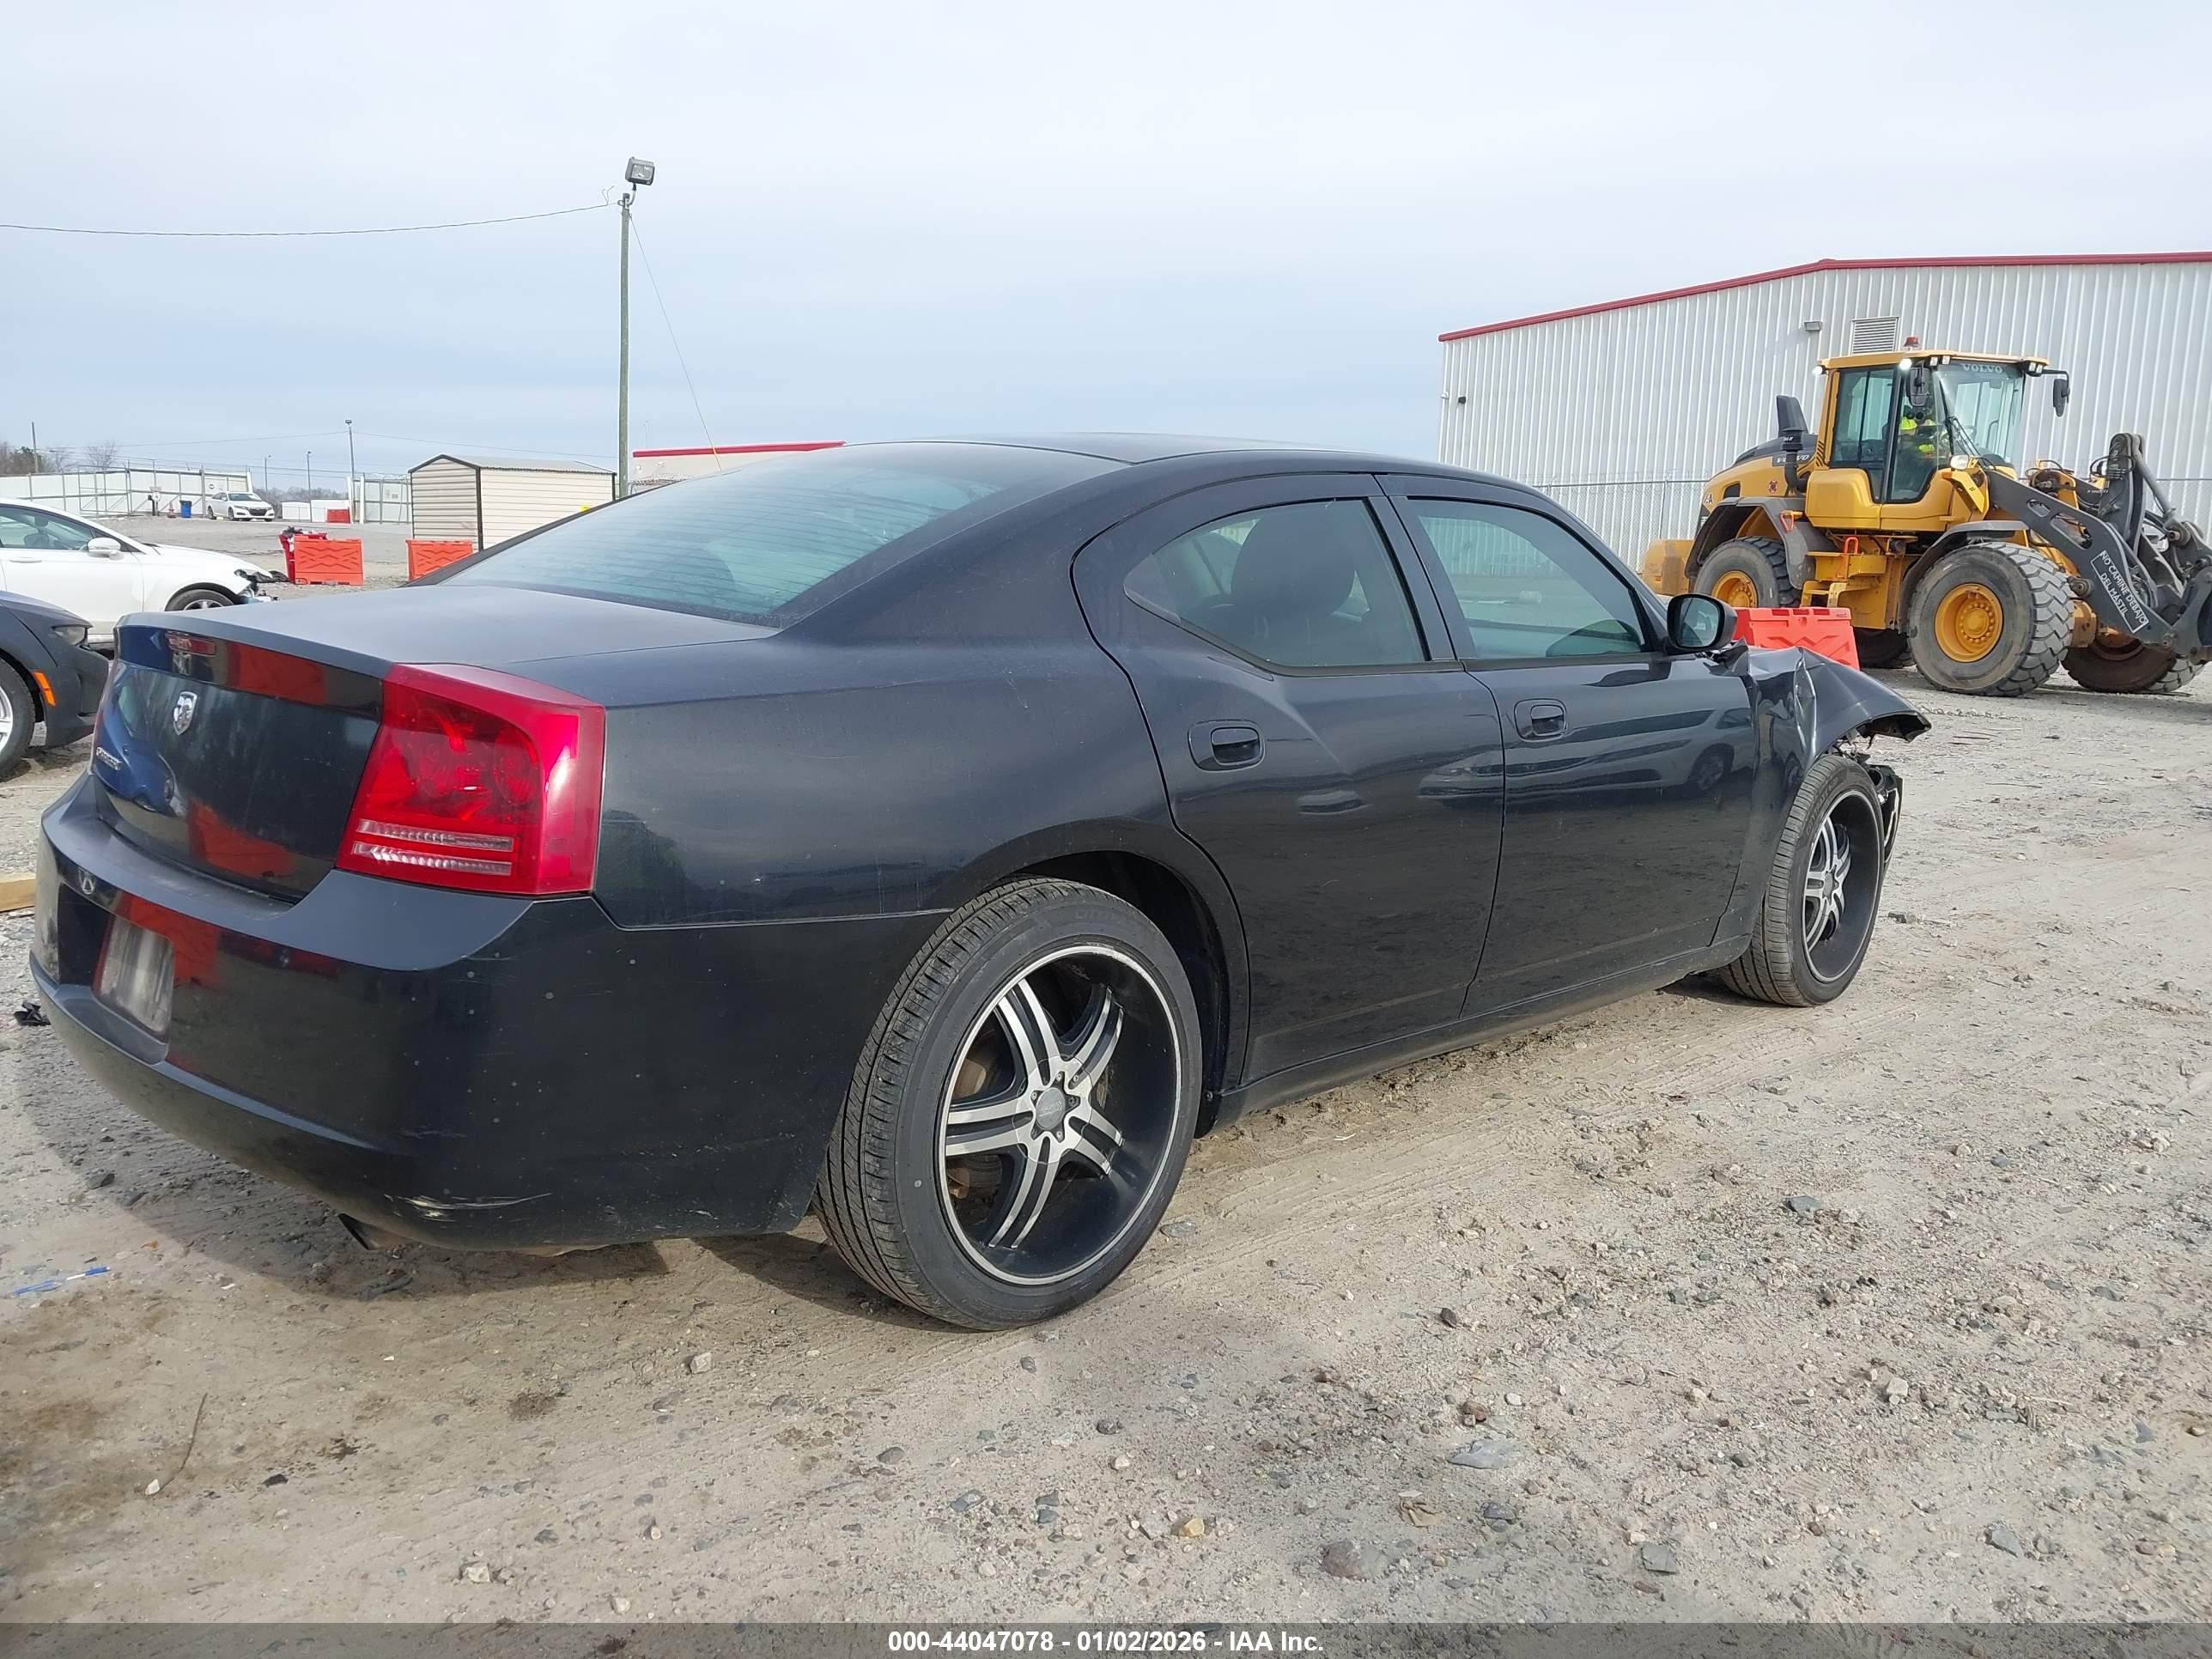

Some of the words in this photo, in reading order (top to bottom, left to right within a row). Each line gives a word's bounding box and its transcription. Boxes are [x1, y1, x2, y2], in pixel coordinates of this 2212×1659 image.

[1962, 364, 2003, 374] VOLVO
[1777, 454, 1810, 464] VVO
[2100, 552, 2112, 566] NO
[2108, 565, 2130, 596] CAMINE
[2125, 593, 2148, 624] DEBAJO
[2100, 572, 2112, 589] DEL
[2108, 586, 2130, 617] MÁSTIL
